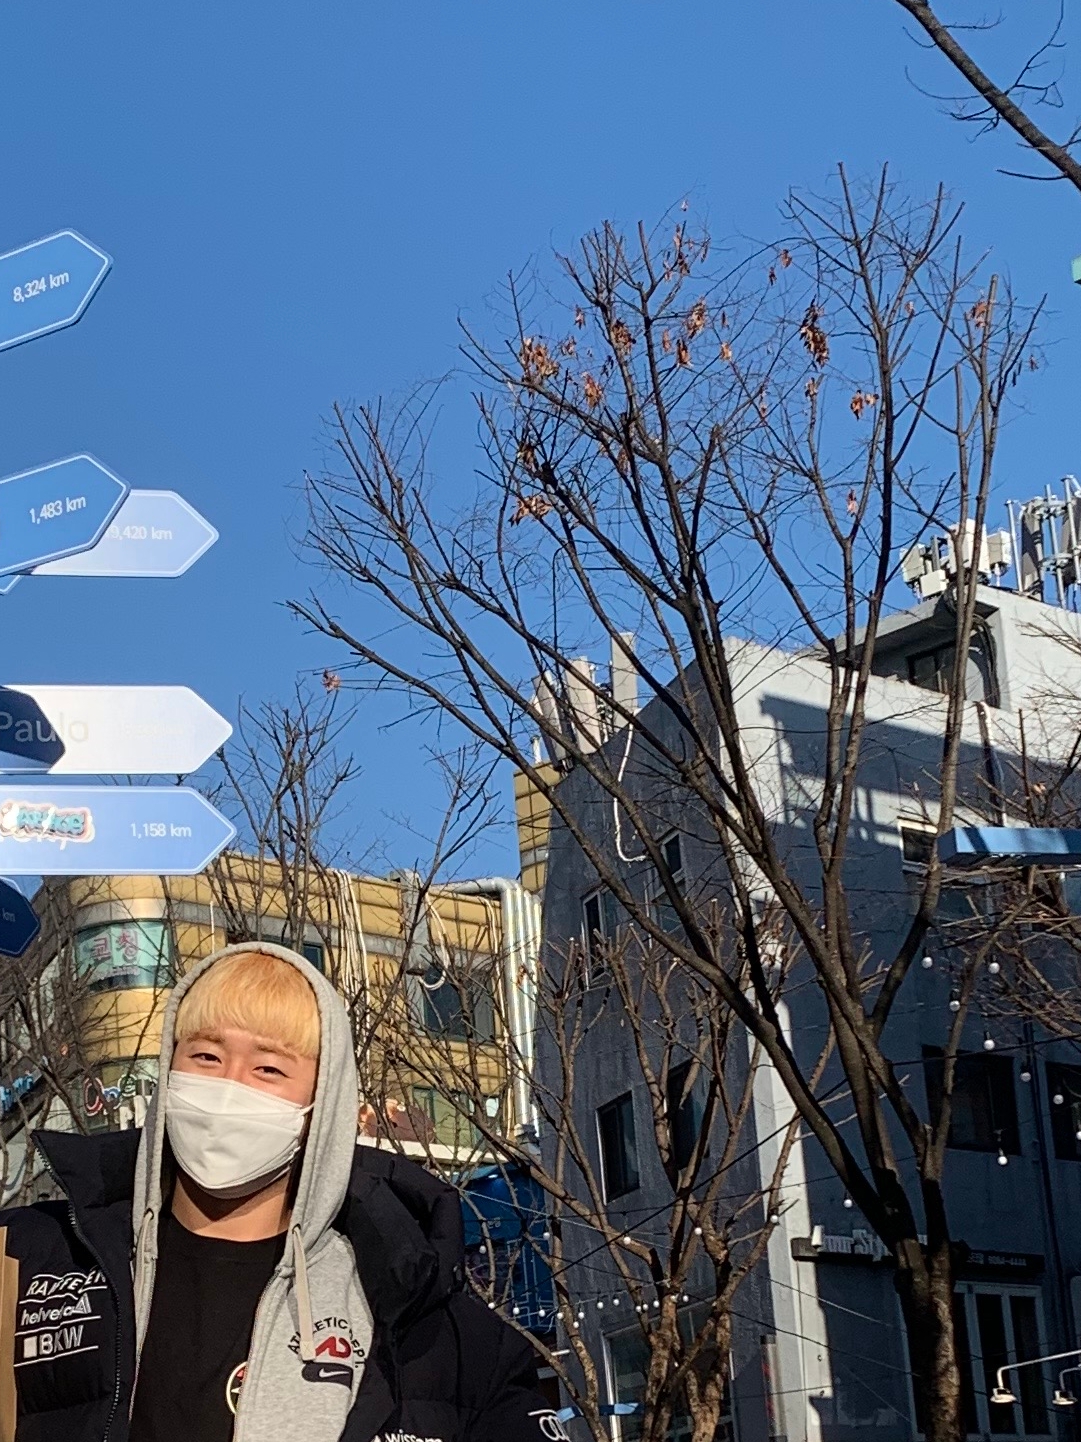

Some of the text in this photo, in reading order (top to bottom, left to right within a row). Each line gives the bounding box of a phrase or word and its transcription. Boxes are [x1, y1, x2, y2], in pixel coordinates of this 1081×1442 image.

[12, 269, 70, 304] 8,324 km
[29, 494, 87, 525] 1,483 km
[151, 526, 173, 540] km
[130, 823, 192, 839] 1,158 km
[1, 906, 16, 923] km
[38, 1325, 85, 1356] BKW
